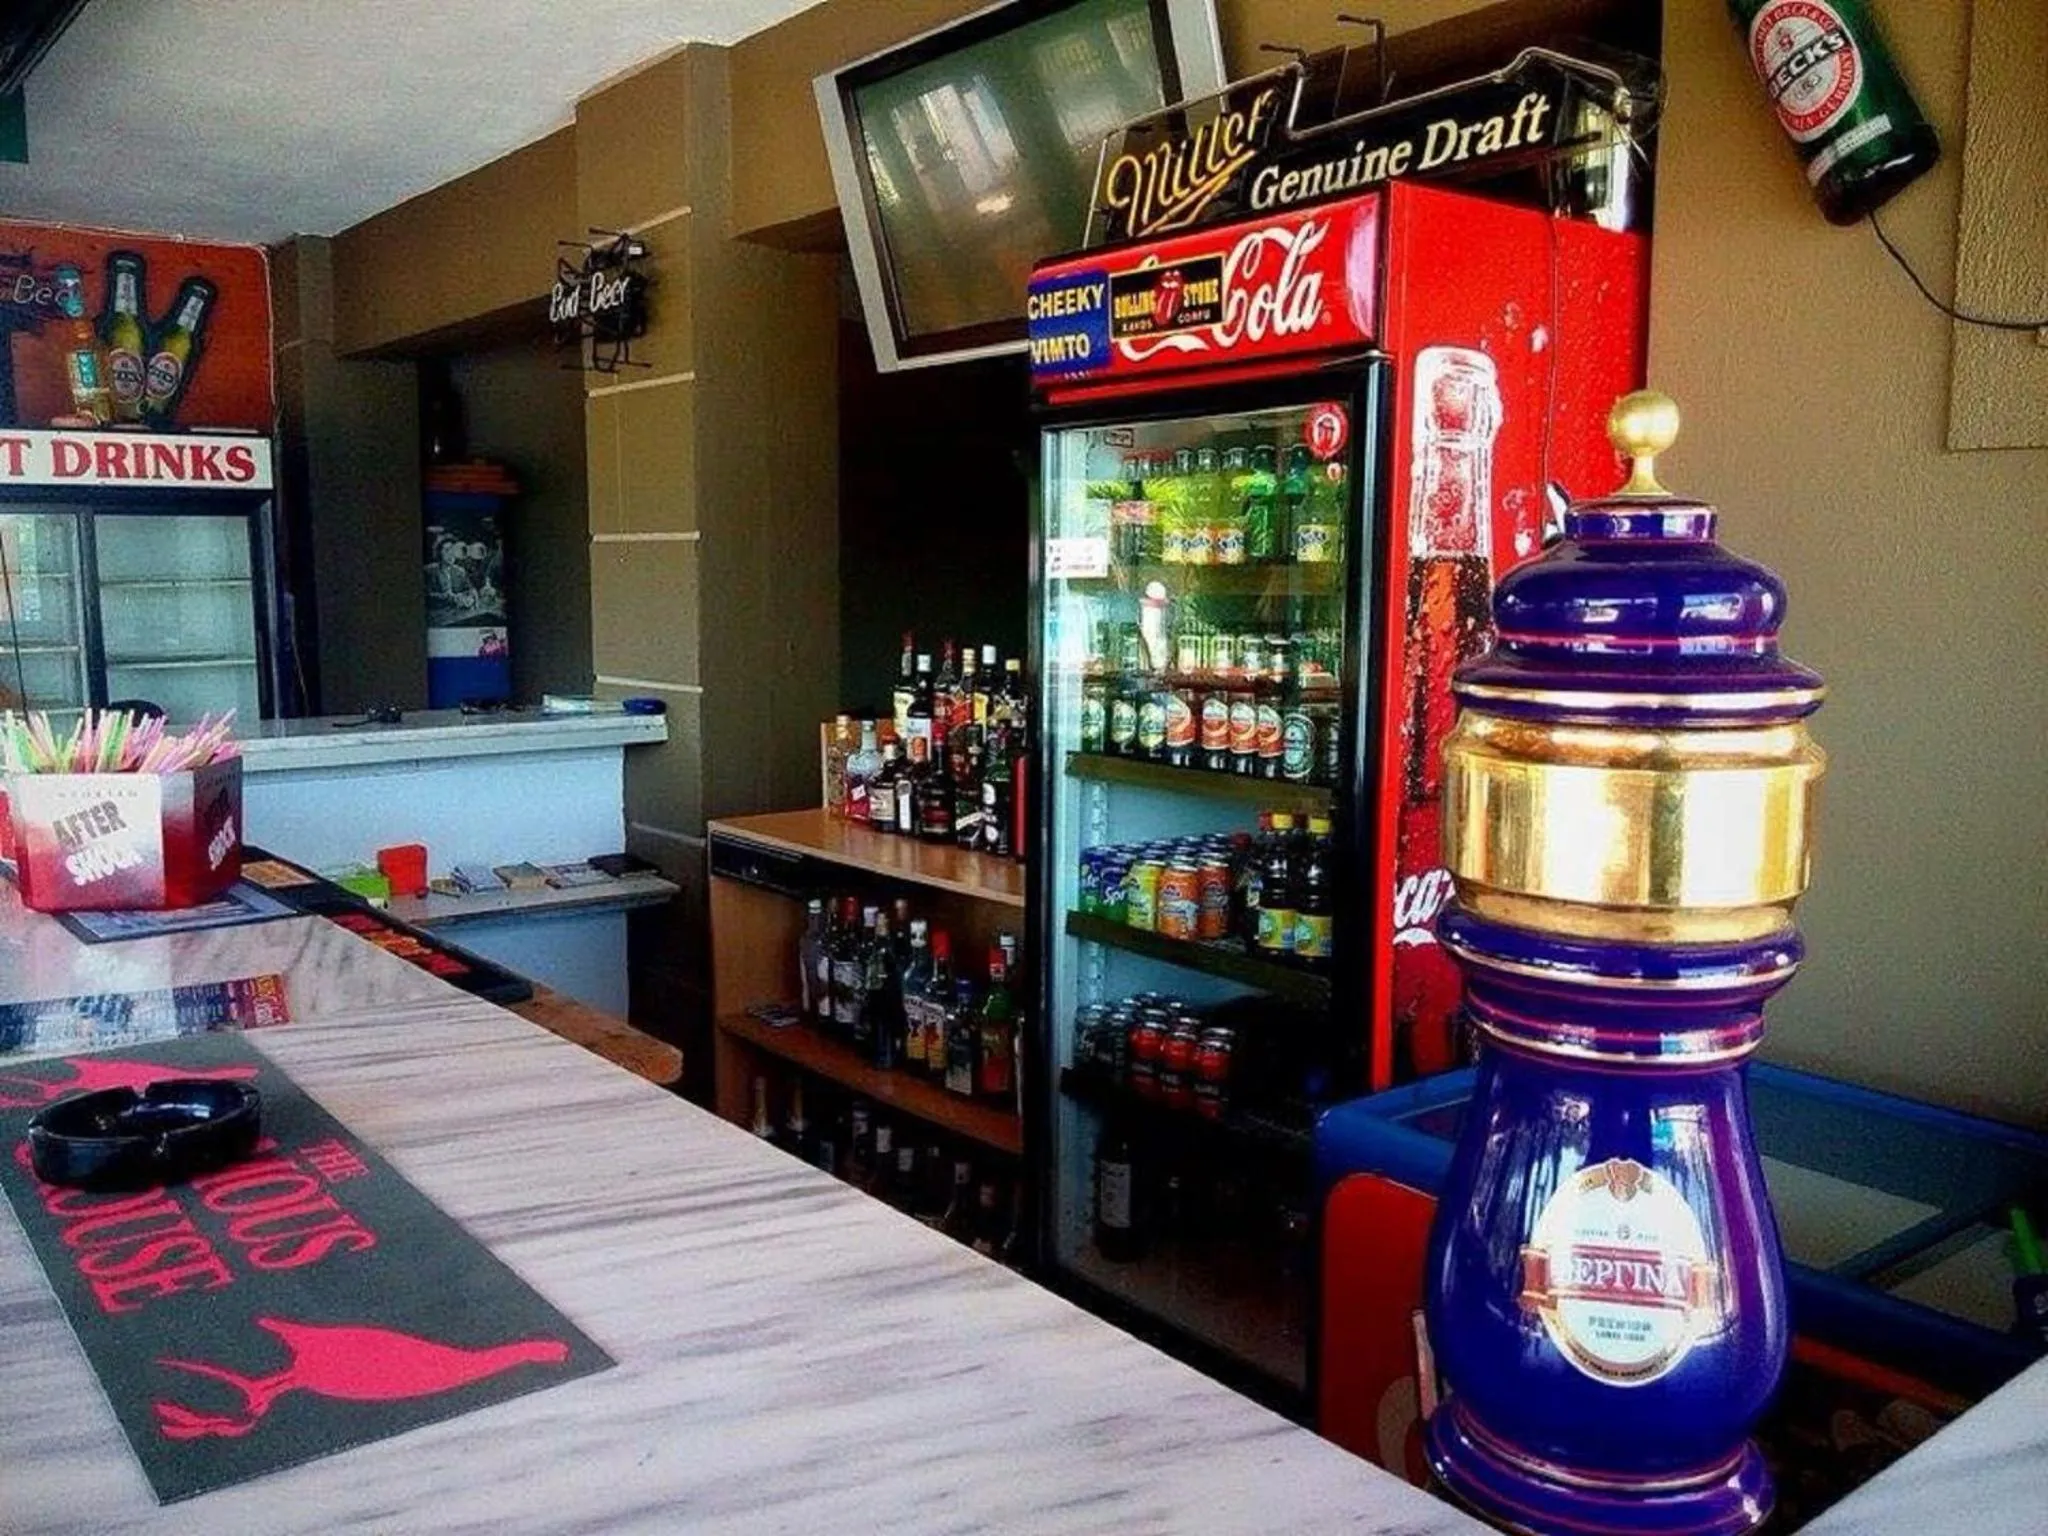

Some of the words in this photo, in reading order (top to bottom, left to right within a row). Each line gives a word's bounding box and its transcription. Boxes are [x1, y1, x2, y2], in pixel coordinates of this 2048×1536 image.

[1107, 89, 1273, 237] Miller
[1251, 140, 1412, 210] Genuine
[1418, 91, 1550, 170] Draft
[1027, 282, 1105, 321] CHEEKY
[1211, 216, 1331, 347] Cola
[1029, 332, 1091, 365] VIMTO
[51, 440, 256, 482] DRINKS
[52, 801, 127, 848] AFTER
[301, 1138, 372, 1184] THE
